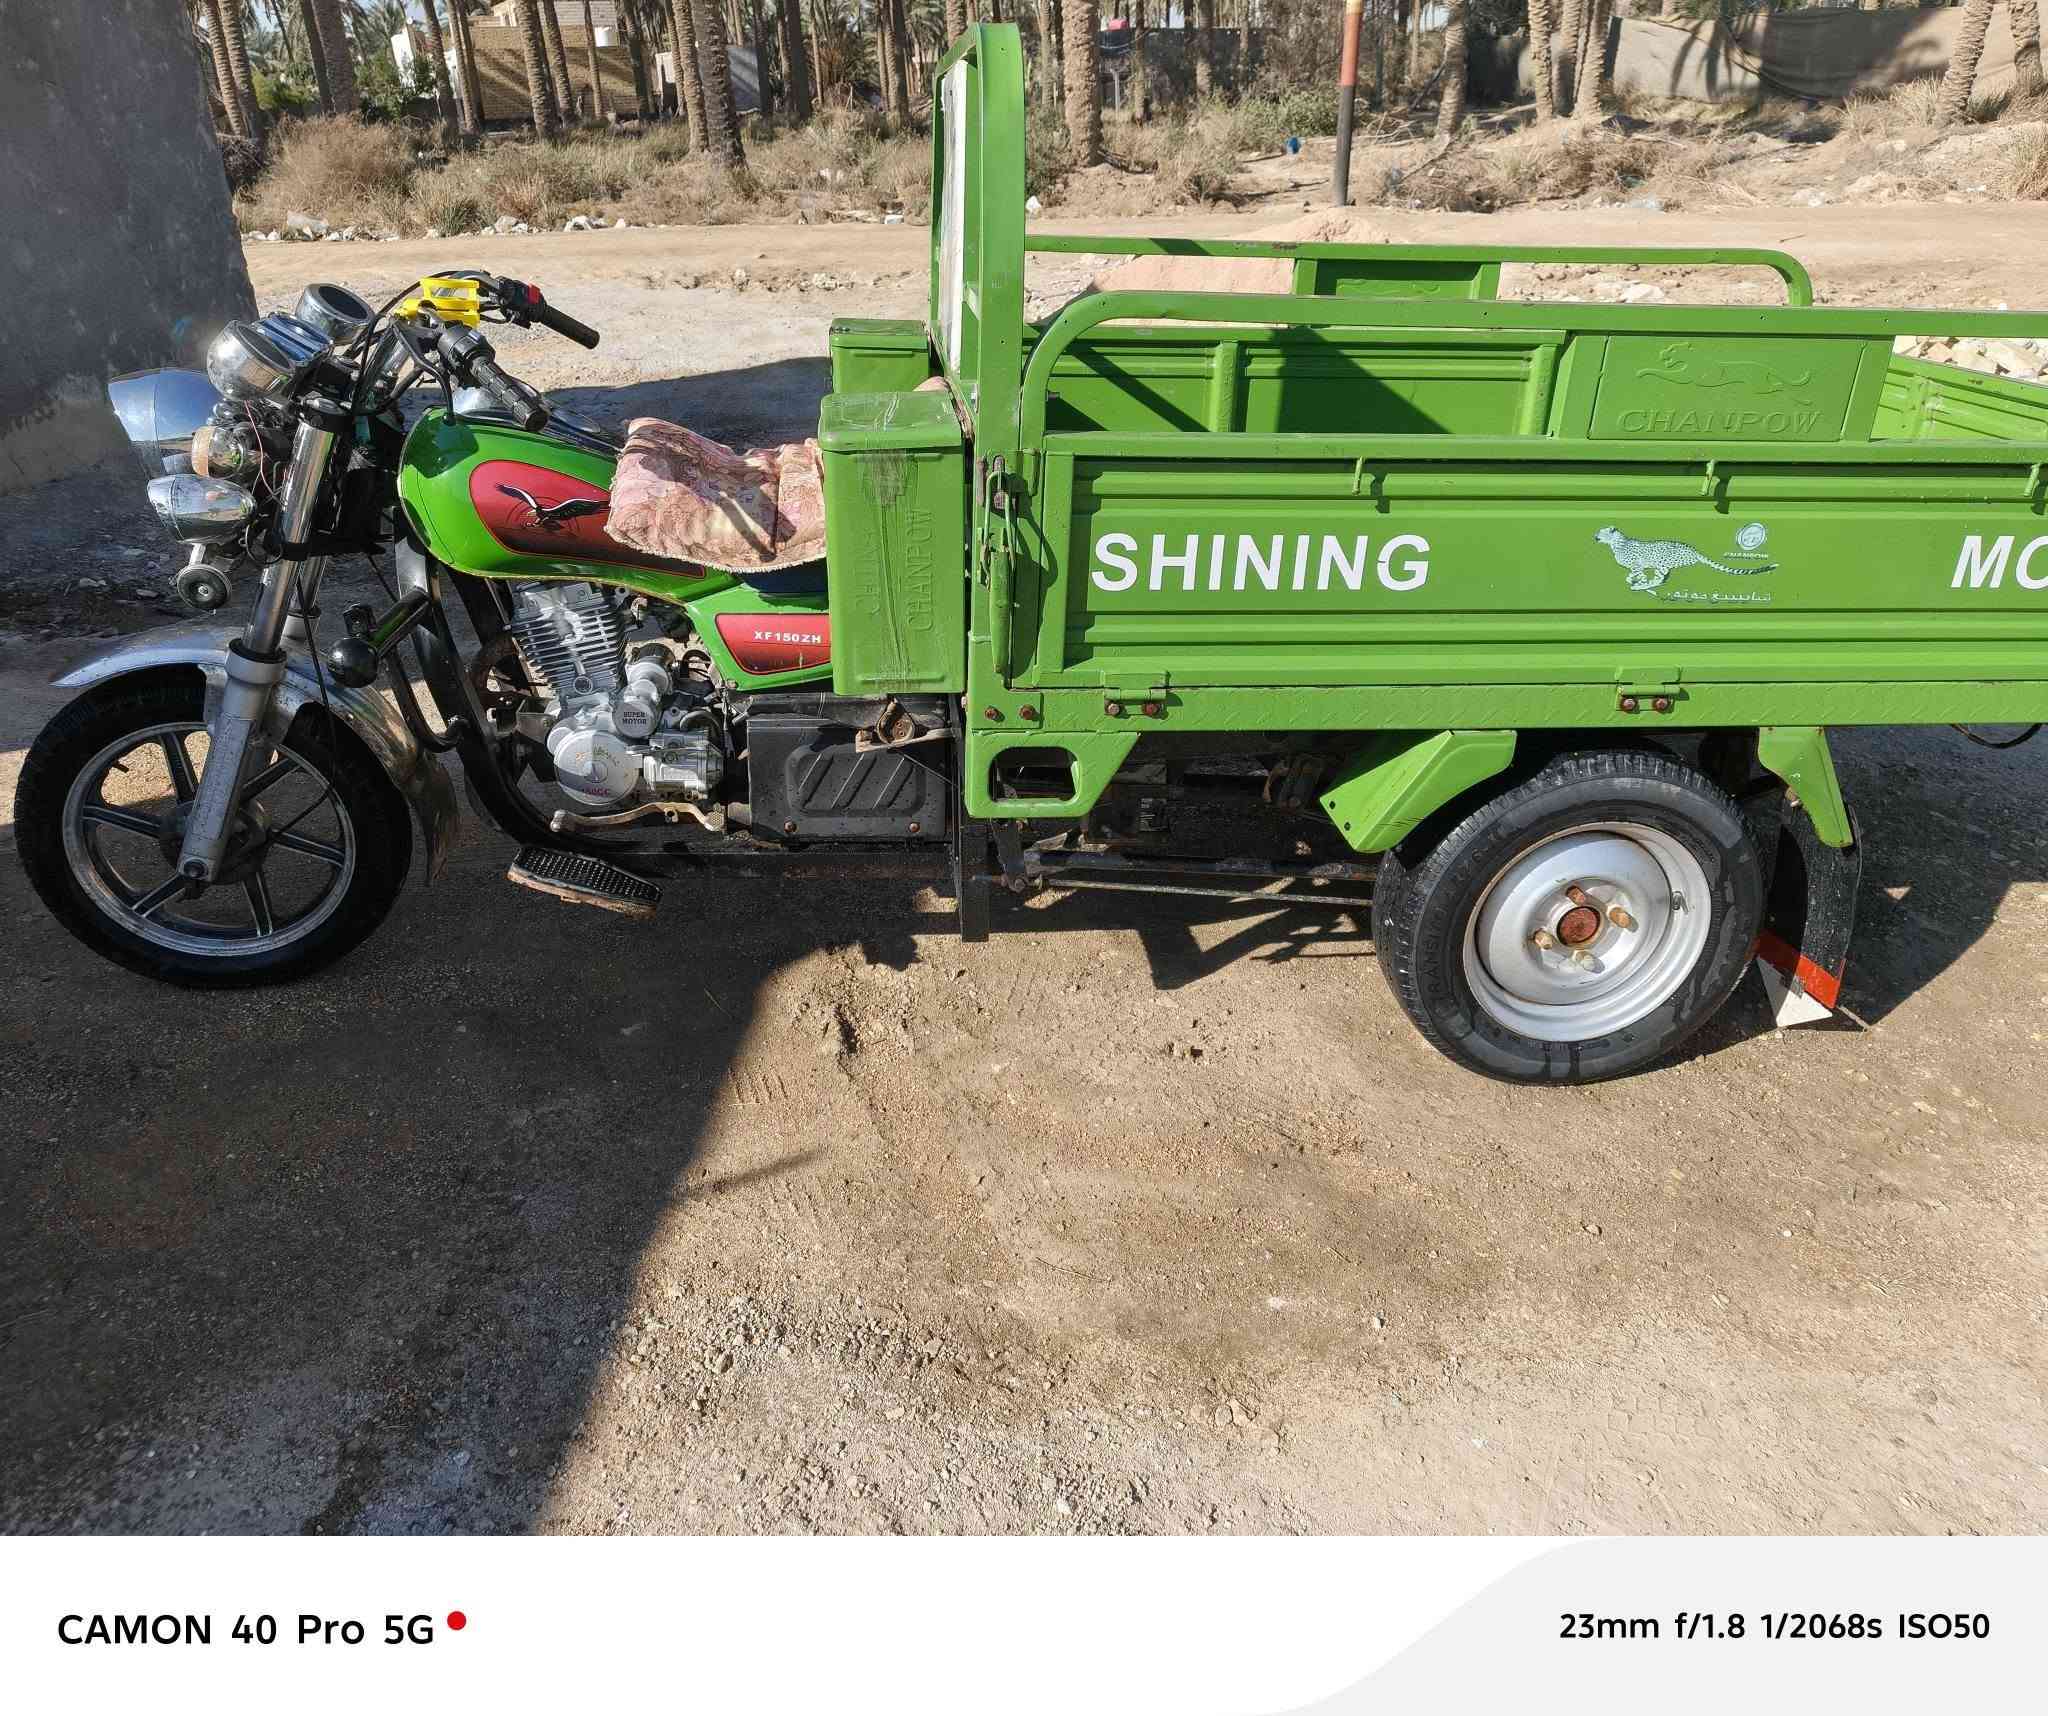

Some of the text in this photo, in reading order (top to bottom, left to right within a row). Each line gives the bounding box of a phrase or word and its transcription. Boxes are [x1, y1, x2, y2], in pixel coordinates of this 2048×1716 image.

[1616, 408, 1824, 433] CHANPOW
[905, 507, 935, 632] CHANPOW
[1091, 532, 1431, 592] SHINING
[754, 630, 822, 644] XF150ZH
